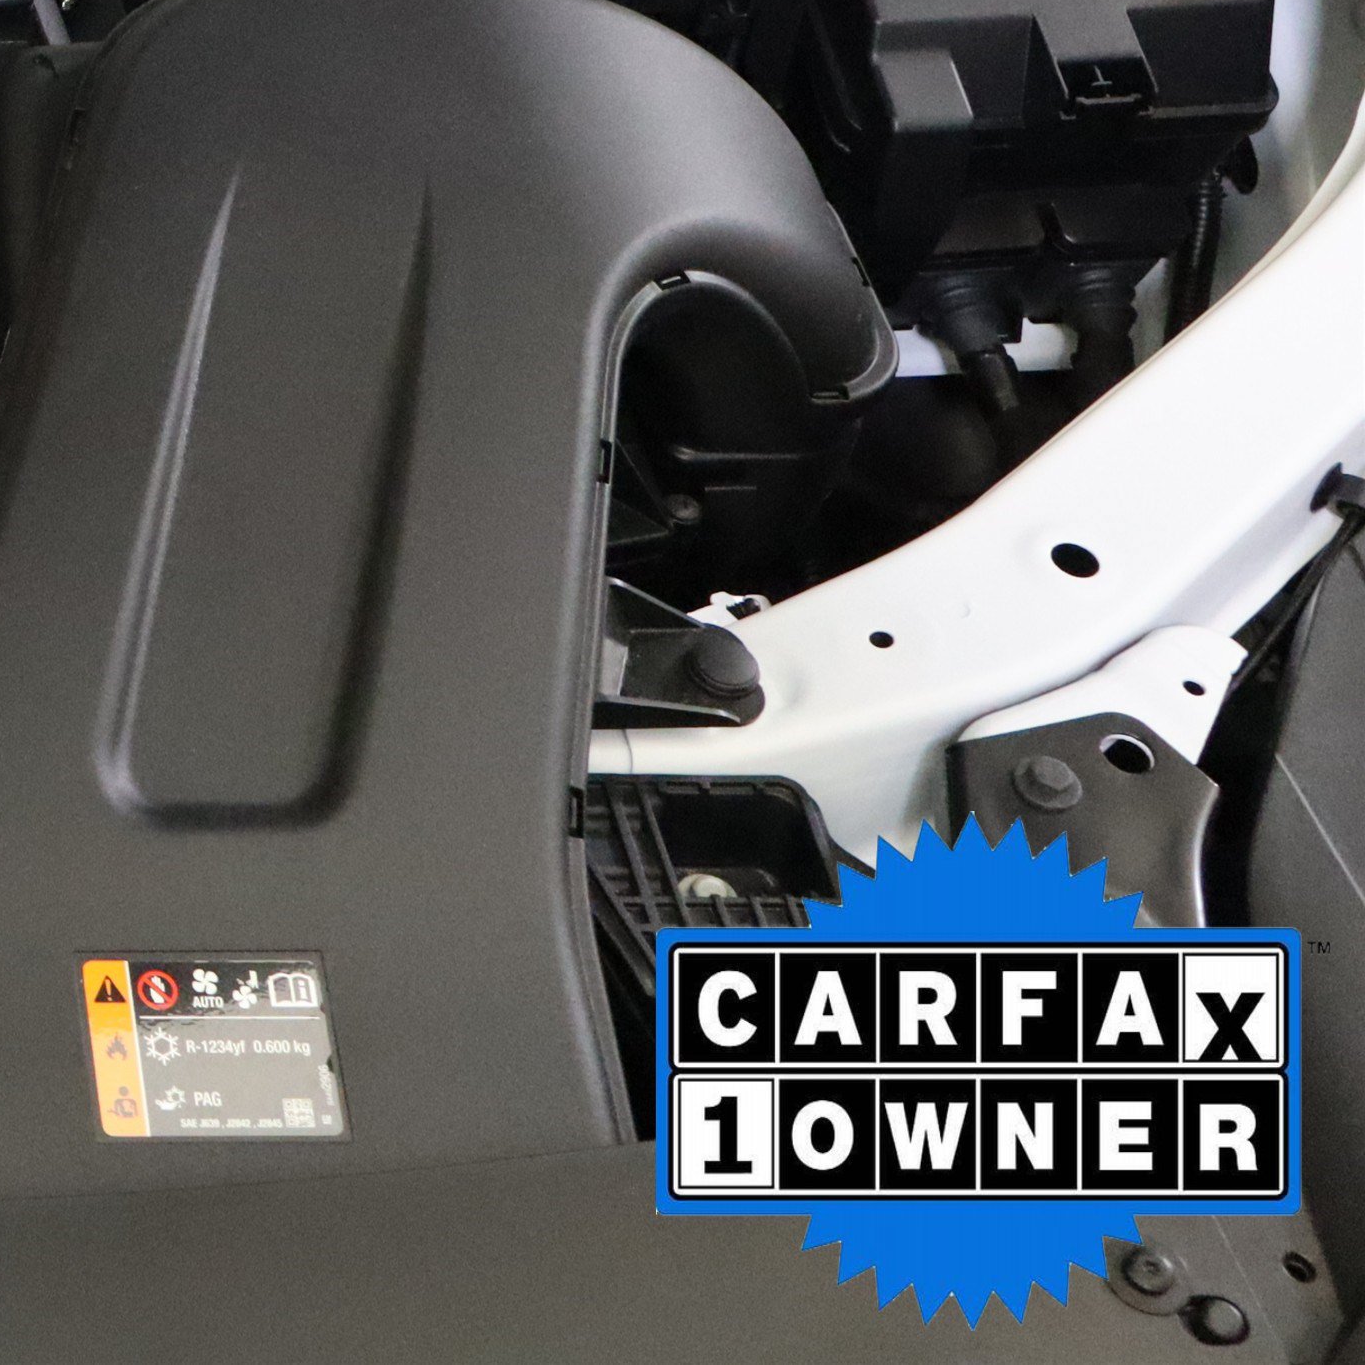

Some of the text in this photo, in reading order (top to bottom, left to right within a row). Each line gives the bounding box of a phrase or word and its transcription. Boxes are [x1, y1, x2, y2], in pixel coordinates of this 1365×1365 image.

[192, 995, 225, 1009] AUTO
[185, 1039, 311, 1056] R-1234yf 0.600 kg
[193, 1091, 223, 1107] PAG
[180, 1118, 197, 1128] SAE
